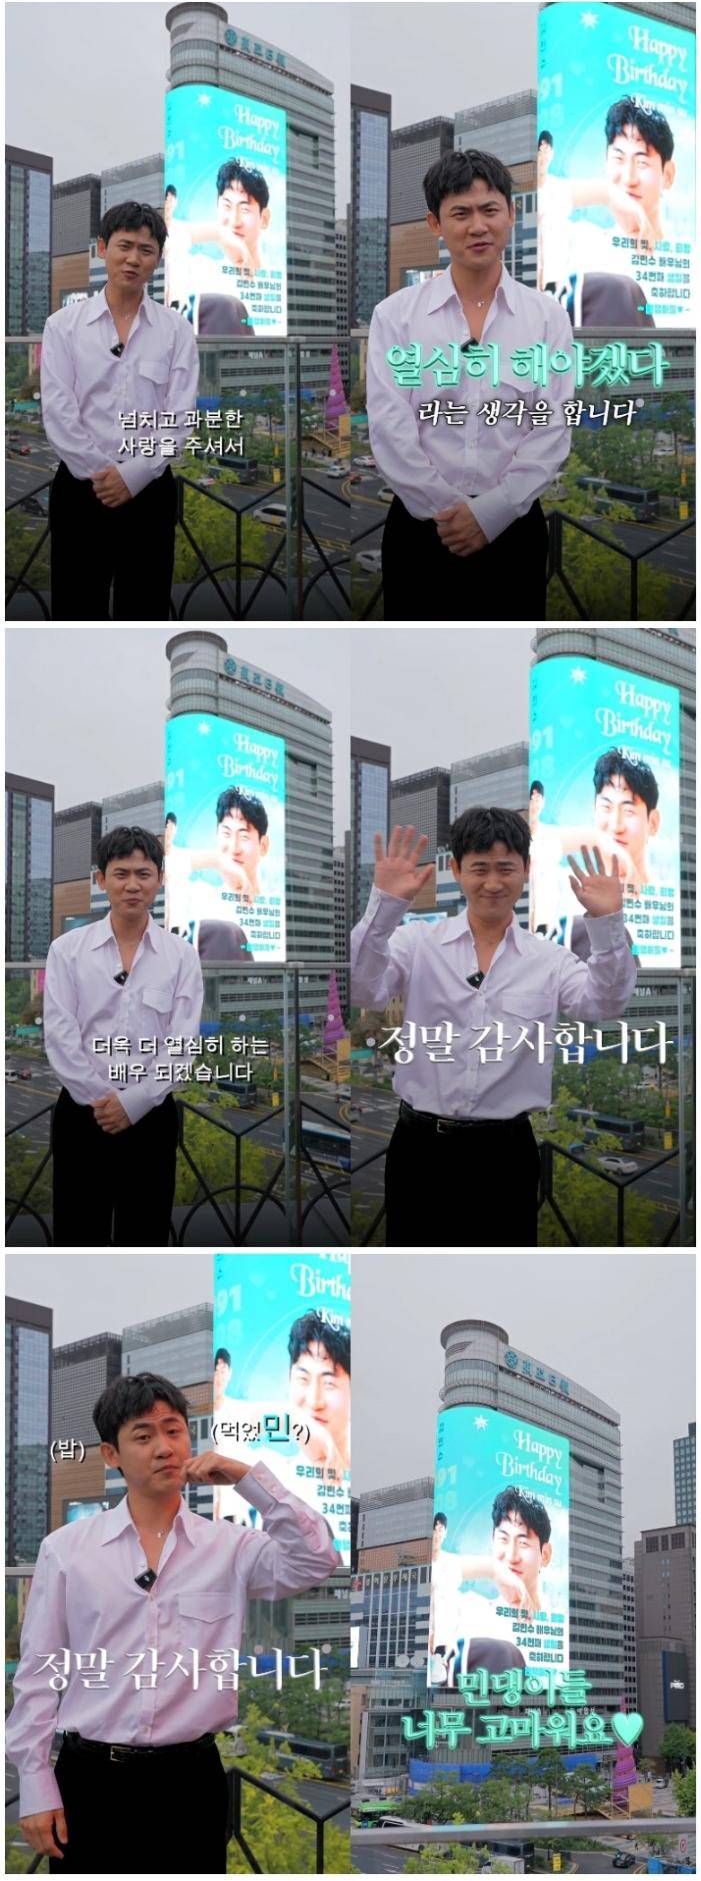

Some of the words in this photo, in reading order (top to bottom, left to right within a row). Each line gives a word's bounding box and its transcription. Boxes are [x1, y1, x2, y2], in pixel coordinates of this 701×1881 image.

[628, 24, 688, 73] Happy
[607, 53, 688, 104] Birthday
[234, 103, 280, 140] Happy
[218, 126, 280, 164] Birthday
[614, 680, 672, 725] Happy
[233, 733, 279, 768] Happy
[595, 707, 672, 755] Birthday
[217, 754, 279, 792] Birthday
[513, 1429, 563, 1469] Happy
[496, 1451, 563, 1495] Birthday
